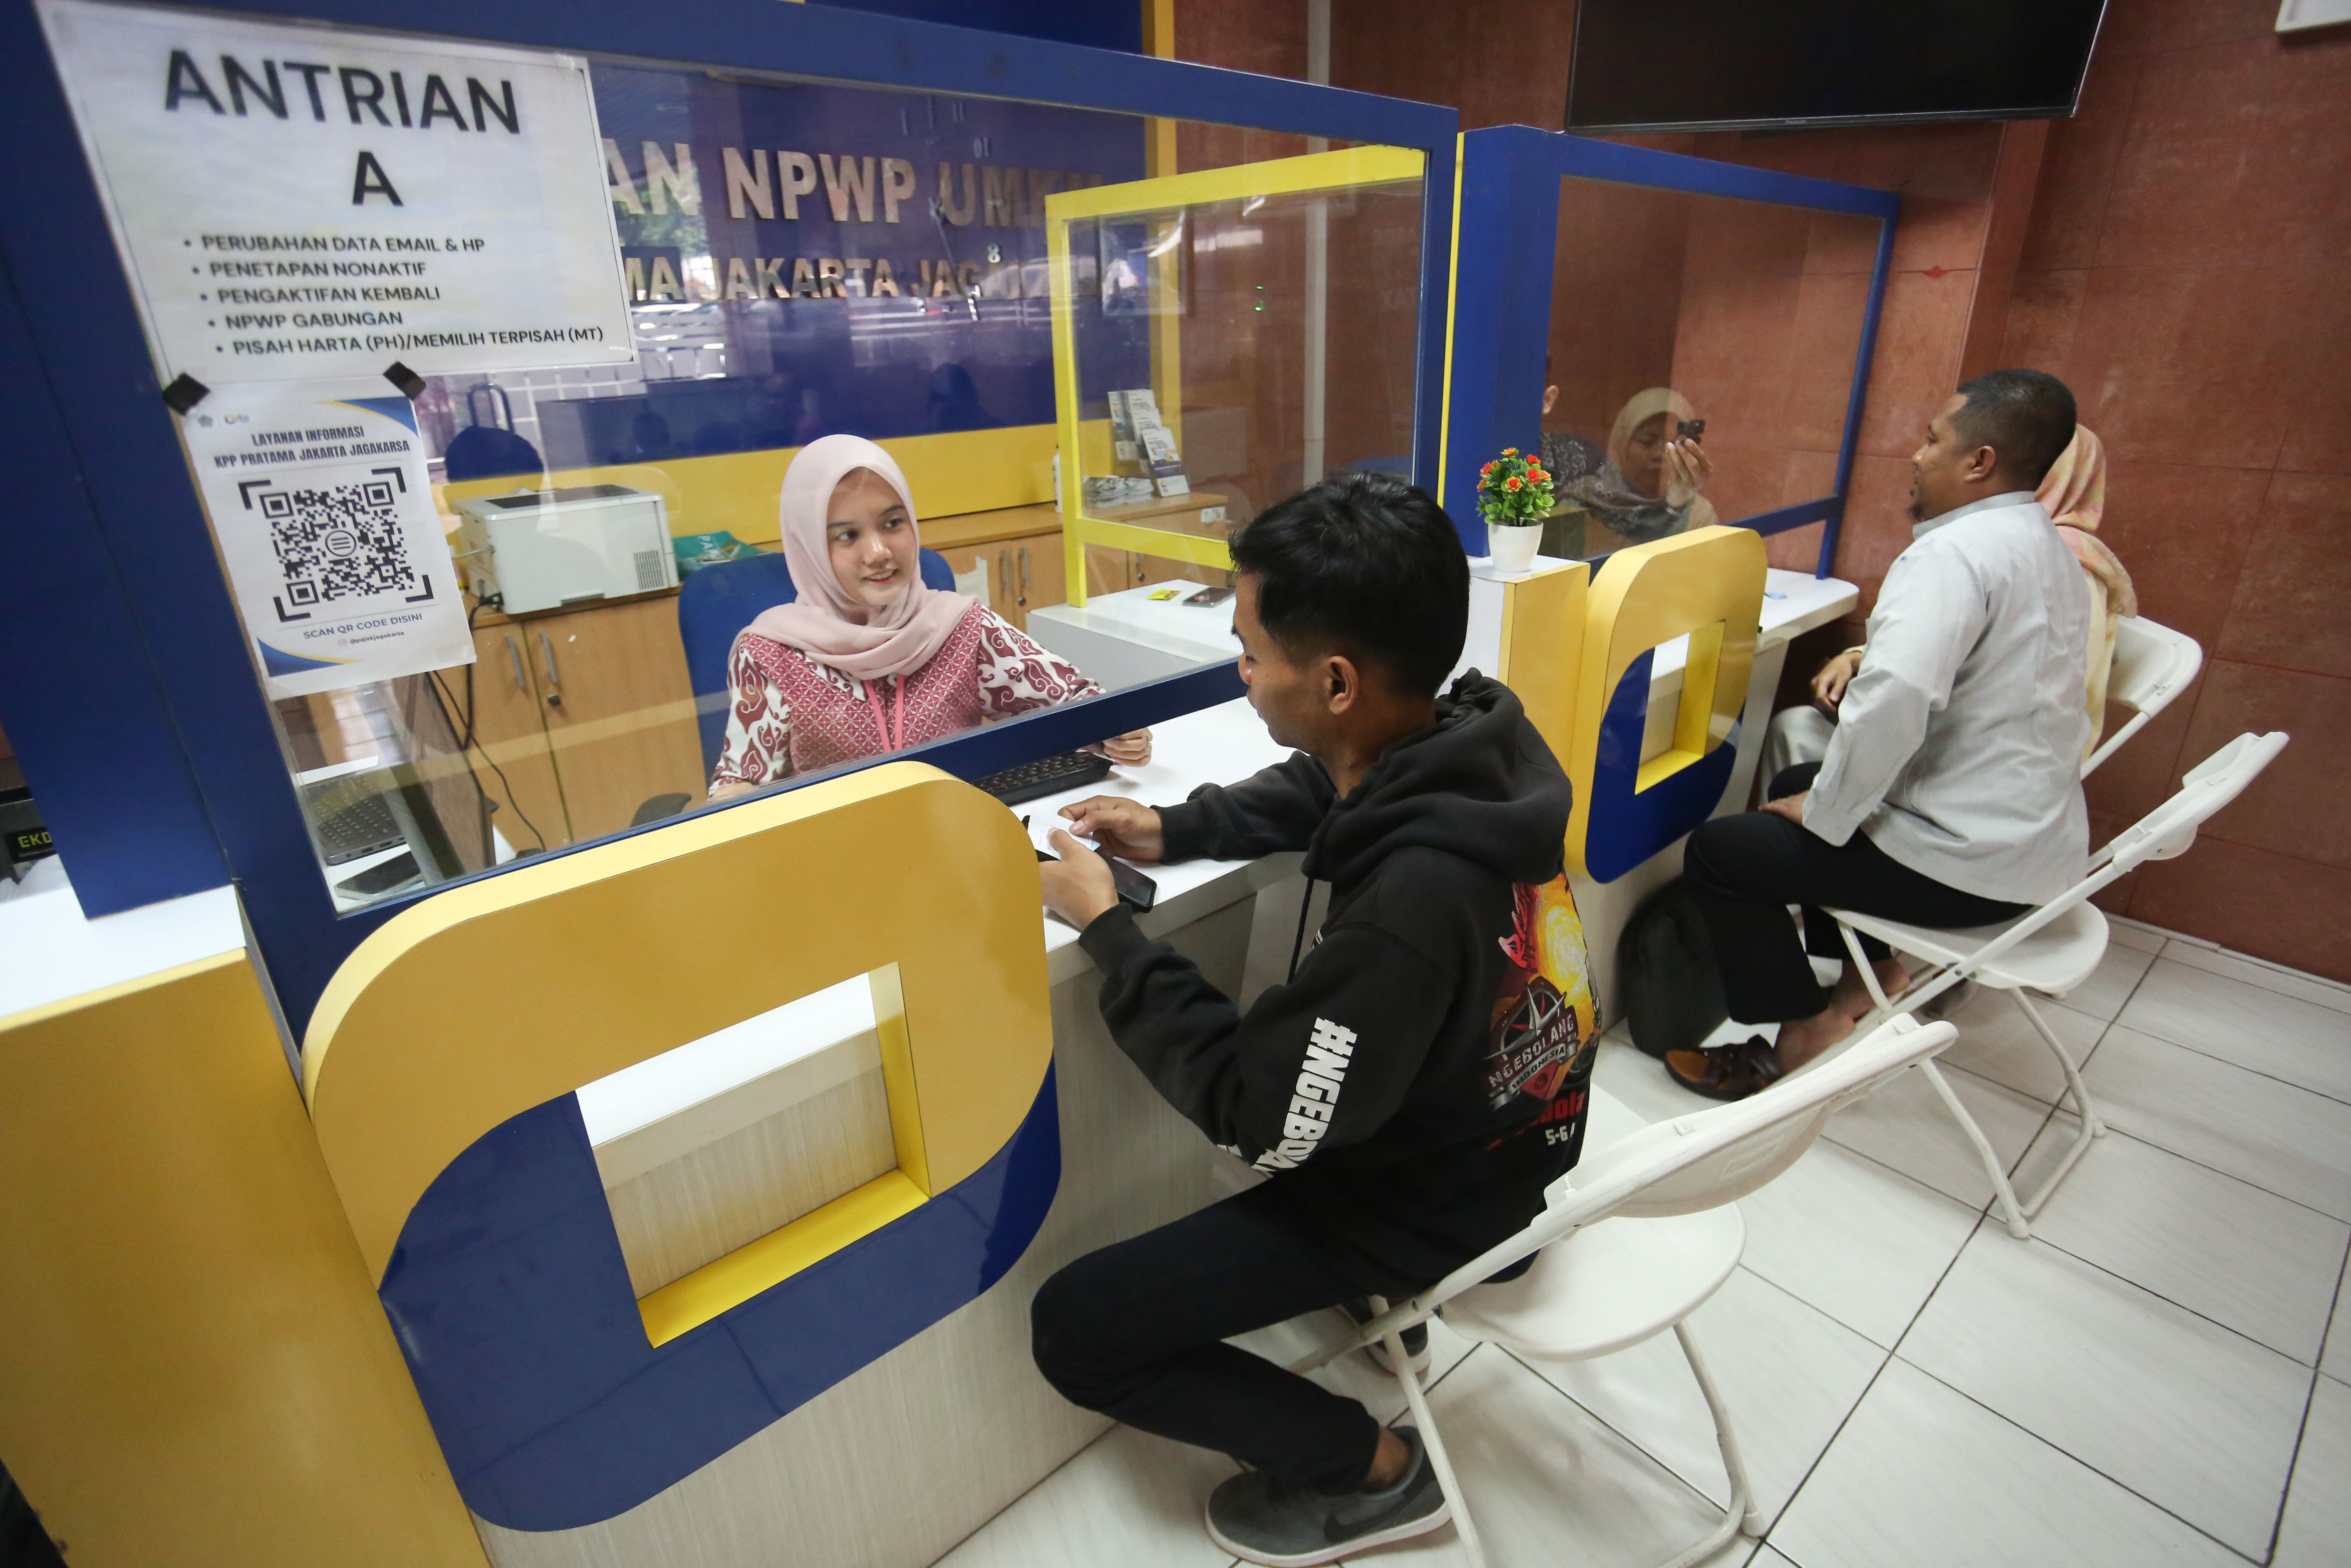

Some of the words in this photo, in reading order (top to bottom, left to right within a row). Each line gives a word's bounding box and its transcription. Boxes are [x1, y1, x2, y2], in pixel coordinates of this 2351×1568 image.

[165, 49, 519, 134] ANTRIAN
[352, 151, 403, 206] A
[723, 147, 916, 223] NPWP
[938, 162, 1102, 227] UMK
[202, 235, 328, 252] PERUBAHAN
[332, 237, 381, 252] DATA
[386, 238, 440, 252] EMAIL
[446, 238, 458, 252] &
[462, 238, 485, 252] HP
[210, 262, 328, 277] PENETAPAN
[333, 262, 426, 276] NONAKTIF
[218, 287, 357, 303] PENGAKTIFAN
[361, 286, 440, 301] KEMBALI
[226, 314, 286, 329] NPWP
[293, 312, 403, 327] GABUNGAN
[233, 339, 293, 355] PISAH
[298, 336, 362, 352] HARTA
[366, 332, 485, 352] (PH)/MEMILIH
[489, 330, 565, 344] TERPISAH
[569, 327, 603, 343] (MT)
[252, 430, 303, 446] LAYANAN
[307, 426, 365, 441] INFORMASI
[214, 455, 236, 468] KPP
[241, 450, 296, 466] PRATAMA
[300, 445, 347, 461] JAKARTA
[350, 440, 410, 456] JAGAKARSA
[304, 627, 335, 639] SCAN
[338, 625, 354, 633] QR
[357, 619, 388, 630] CODE
[390, 613, 422, 624] DISINI
[350, 631, 404, 644] @pajakjagakarsa
